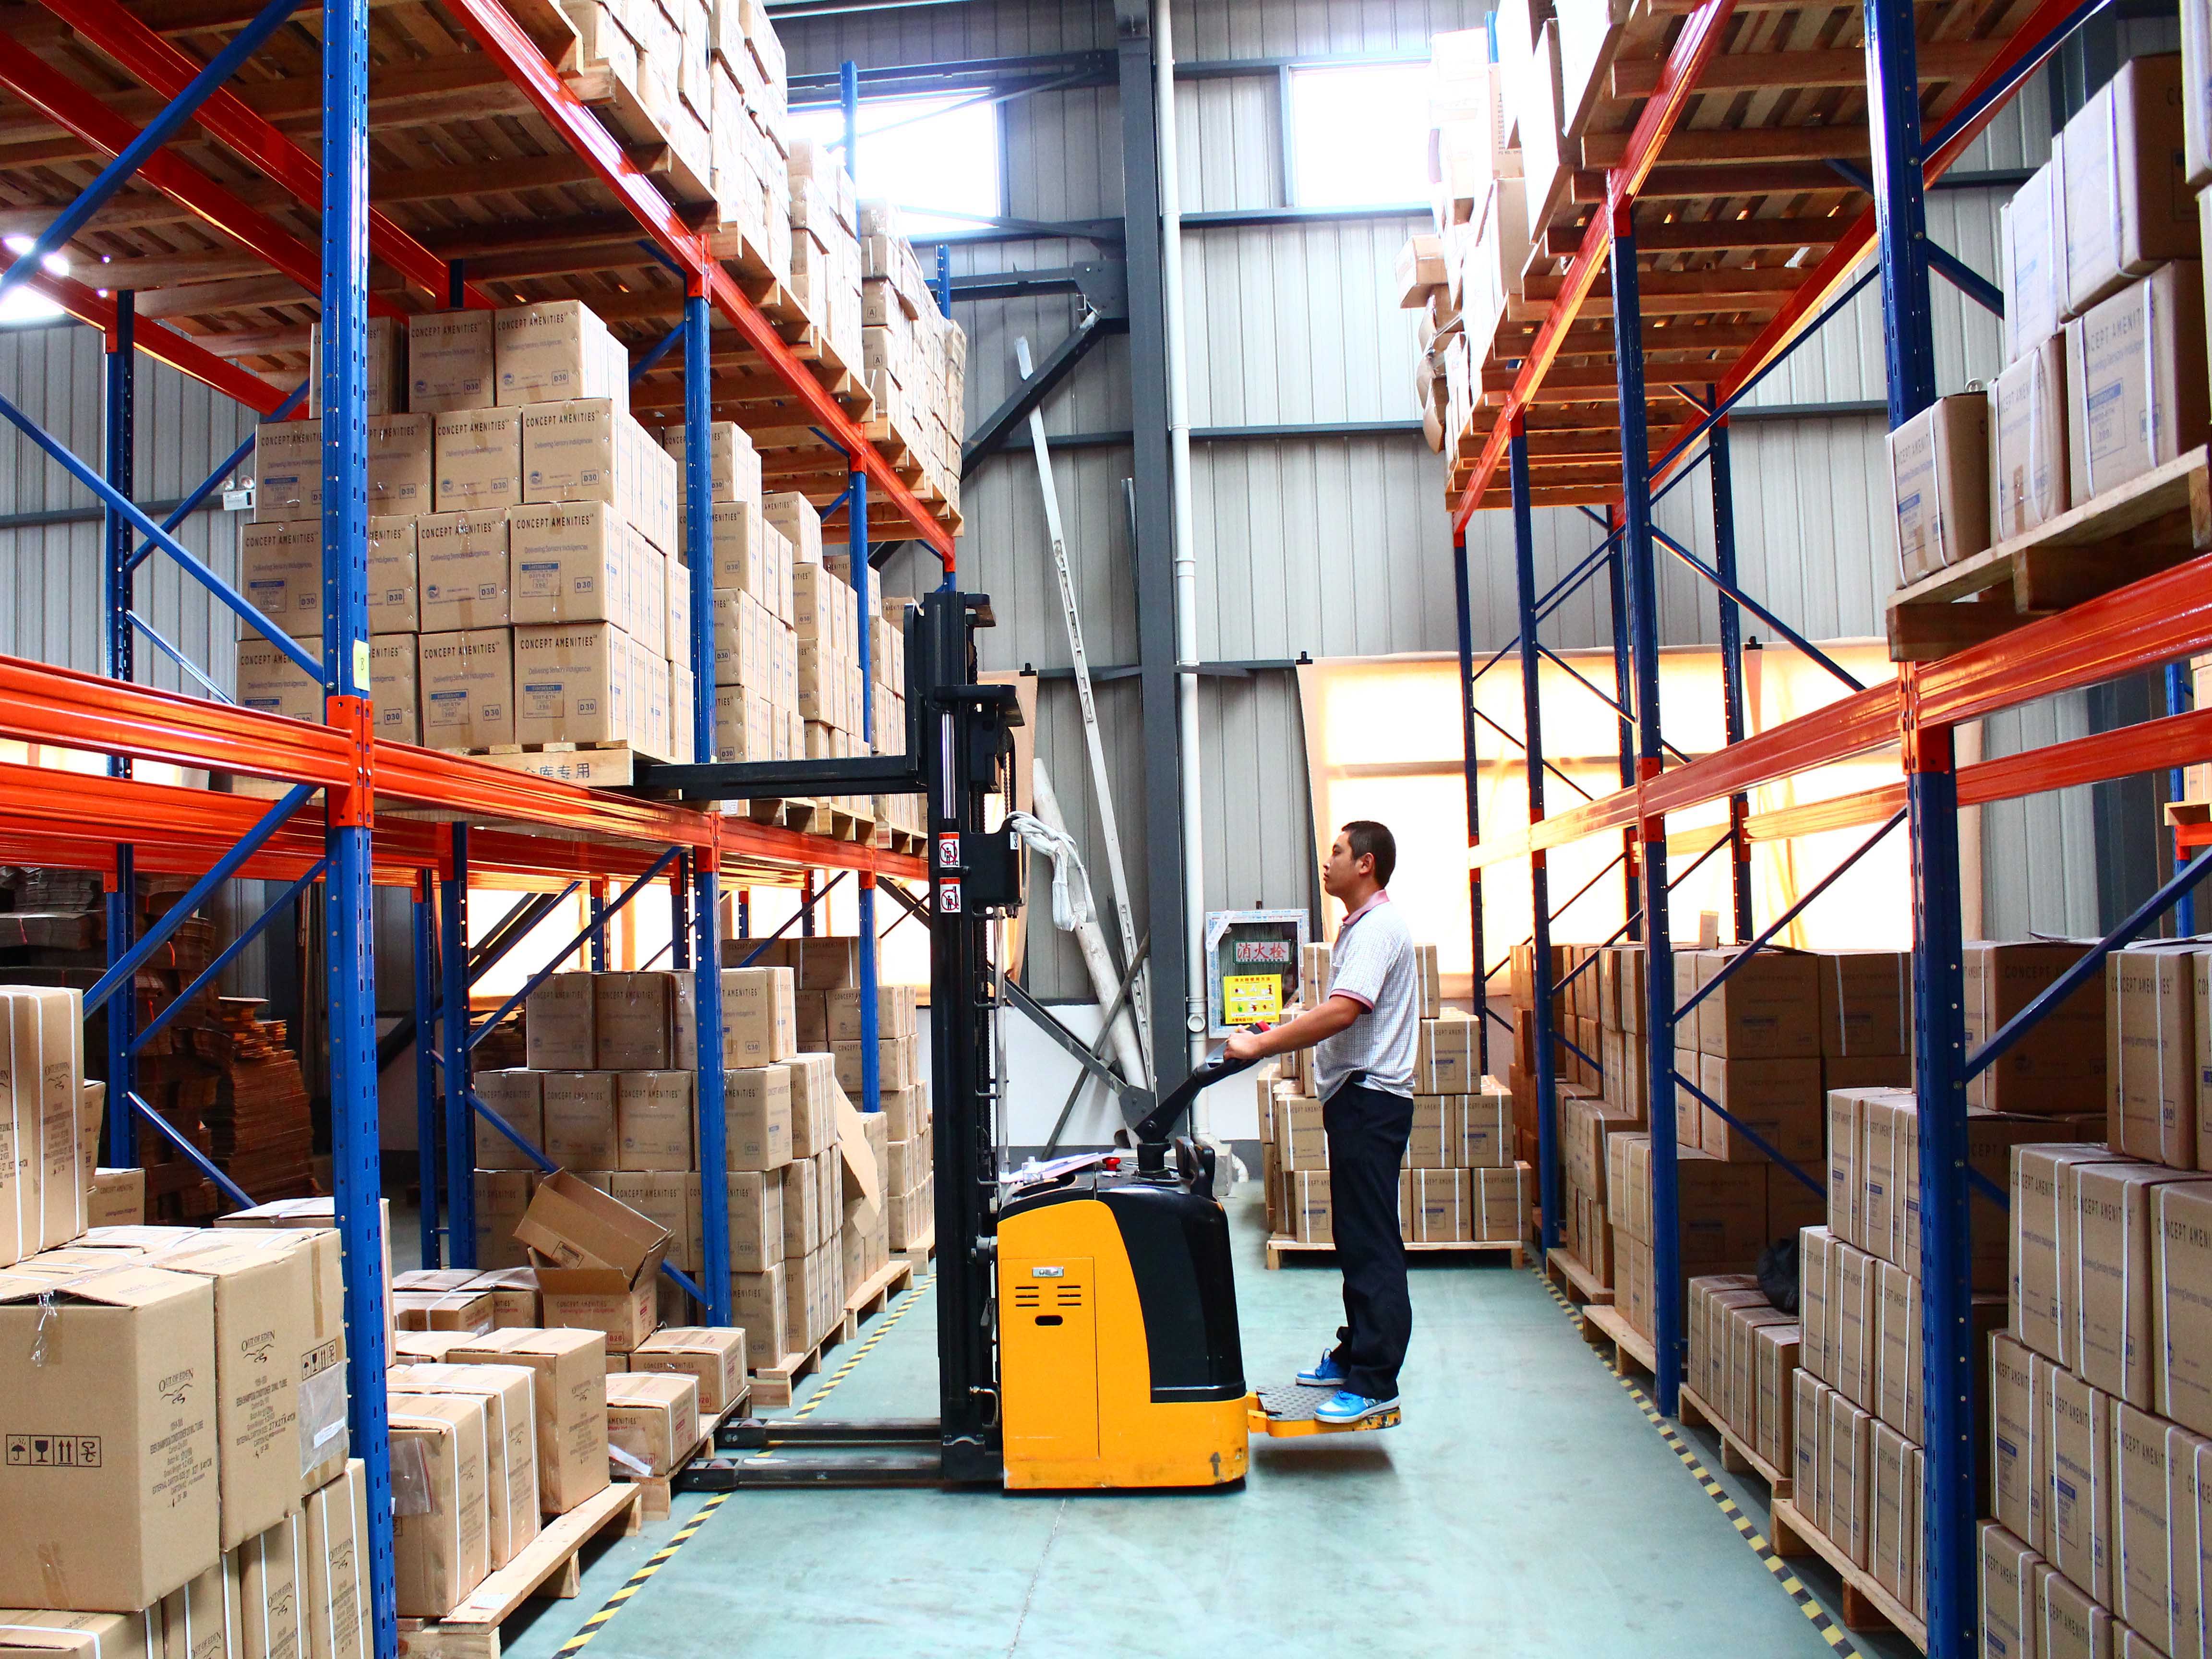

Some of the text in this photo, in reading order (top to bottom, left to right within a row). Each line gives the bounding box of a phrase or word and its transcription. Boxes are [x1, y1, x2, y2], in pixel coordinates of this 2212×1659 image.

[498, 314, 564, 330] CONCEPT AMENITIES
[411, 323, 478, 337] CONCEPT AMENITIES
[526, 412, 595, 427] CONCEPT AMENITIES
[437, 421, 505, 436] CONCEPT AMENITIES
[261, 435, 289, 446] CONCEPT
[665, 436, 685, 445] CONCEP
[765, 501, 790, 510] AMENITIES
[517, 516, 589, 529] CONCEPT AMENITIES
[711, 512, 737, 522] MENITIES
[421, 524, 491, 539] CONCEPT AMENITIES
[246, 533, 314, 547] CONCEPT AMENITIES
[520, 636, 593, 649] CONCEPT AMENITIES
[424, 644, 495, 659] CONCEPT AMENITIES
[240, 654, 271, 665] CONCEPT
[1238, 942, 1286, 959] 消火栓
[599, 990, 654, 999] CONCEPT AMENITIES
[728, 988, 757, 997] AMENITIES
[574, 1092, 602, 1100] AMENITIES
[649, 1090, 678, 1098] AMENITIES
[725, 1089, 755, 1097] AMENITIES
[616, 1189, 677, 1198] CONCEPT AMENITIES
[733, 1290, 761, 1298] MENITIES
[242, 1330, 275, 1351] OUT OF EDEN
[159, 1368, 193, 1392] OUT OF EDEN
[268, 1590, 277, 1608] OUT
[207, 1632, 222, 1646] EDEN
